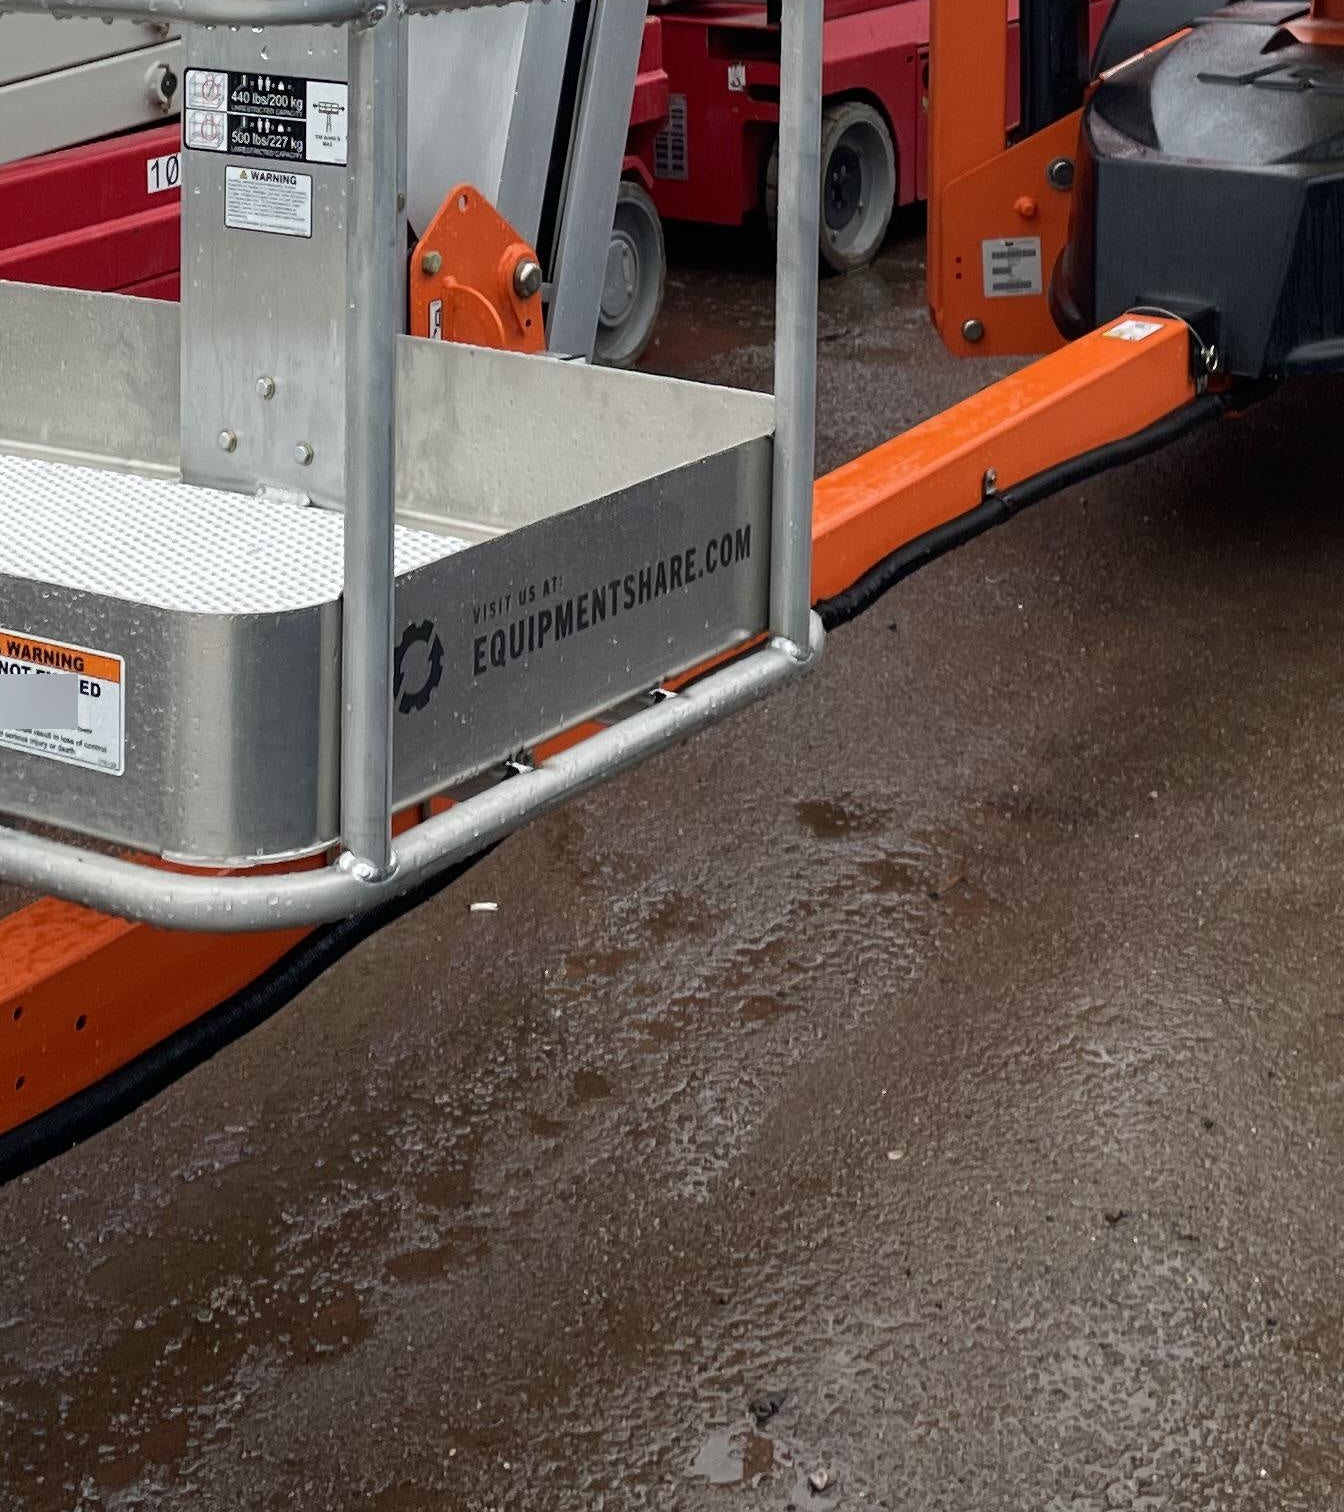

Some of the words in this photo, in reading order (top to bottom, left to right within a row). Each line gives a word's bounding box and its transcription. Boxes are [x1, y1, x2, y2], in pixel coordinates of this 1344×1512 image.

[231, 91, 250, 104] 440
[252, 92, 289, 107] lbs/200
[290, 96, 303, 111] kg
[231, 131, 250, 144] 500
[252, 133, 289, 148] lbs/227
[290, 136, 303, 152] kg
[250, 170, 297, 186] WARNING
[473, 594, 511, 625] VISIT
[519, 586, 536, 607] US
[543, 576, 564, 598] AT:
[473, 524, 752, 677] EQUIPMENTSHARE.COM
[6, 641, 85, 672] WARNING
